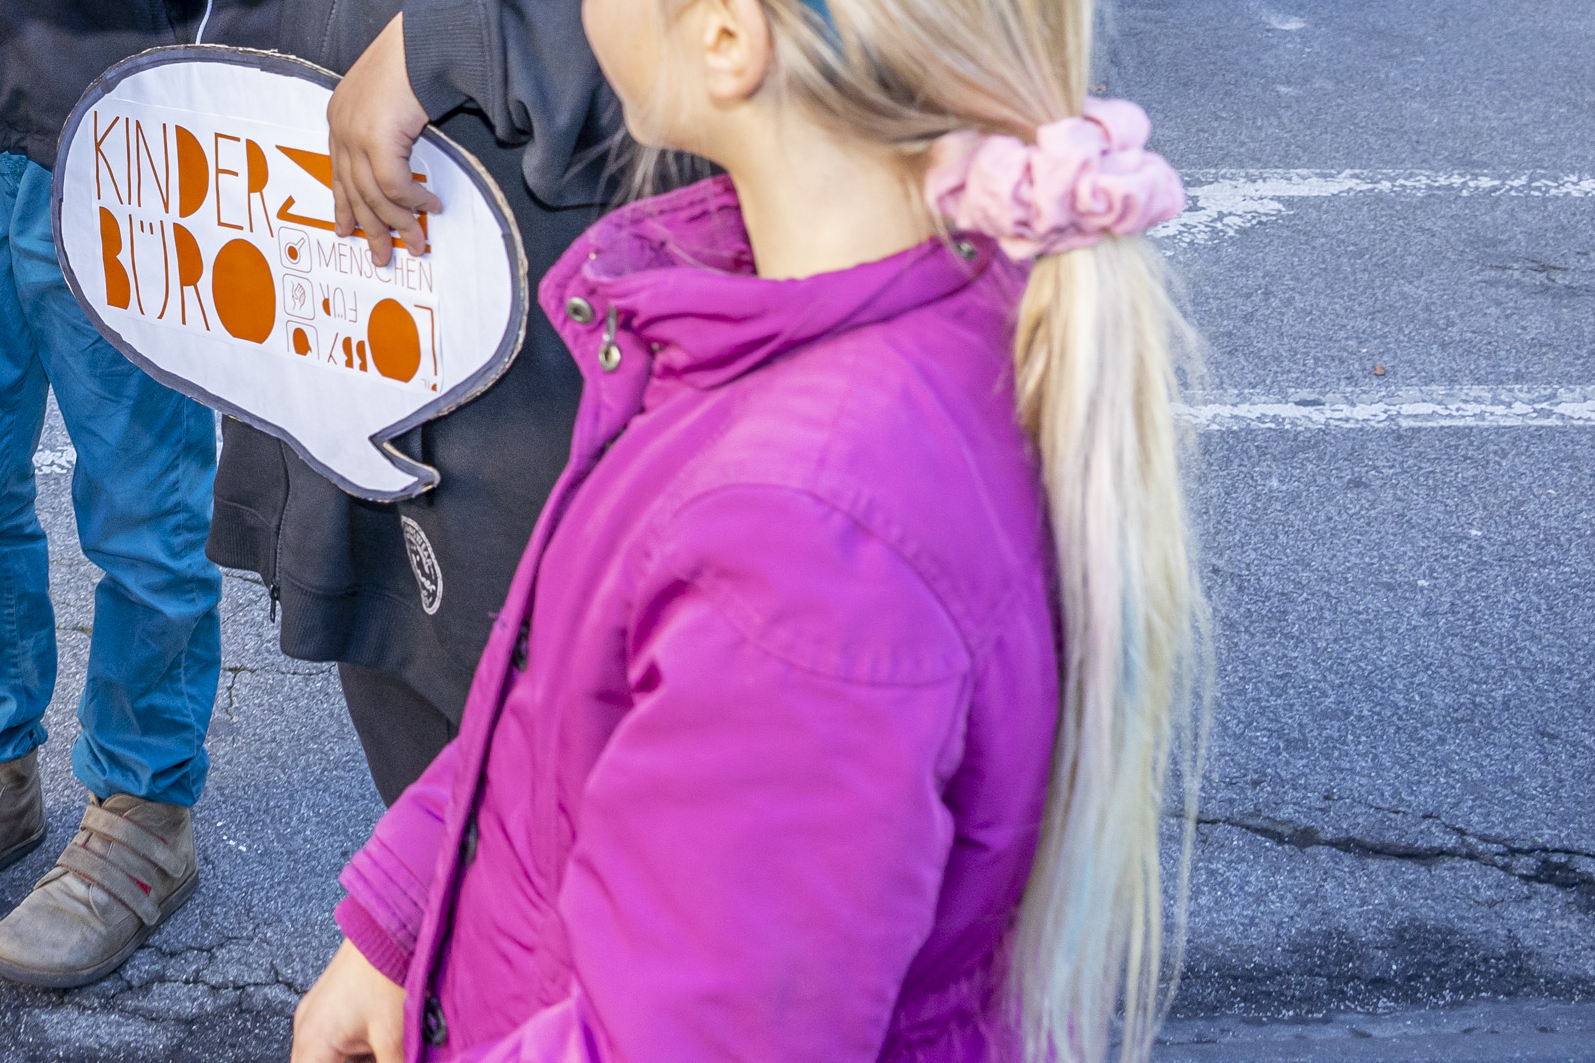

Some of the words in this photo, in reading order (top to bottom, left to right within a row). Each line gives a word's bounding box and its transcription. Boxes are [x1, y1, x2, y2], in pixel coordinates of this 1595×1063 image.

[93, 110, 274, 237] KINDER
[99, 206, 277, 345] BÜRO
[317, 239, 434, 293] MENSCHEN
[319, 282, 358, 323] FÜR
